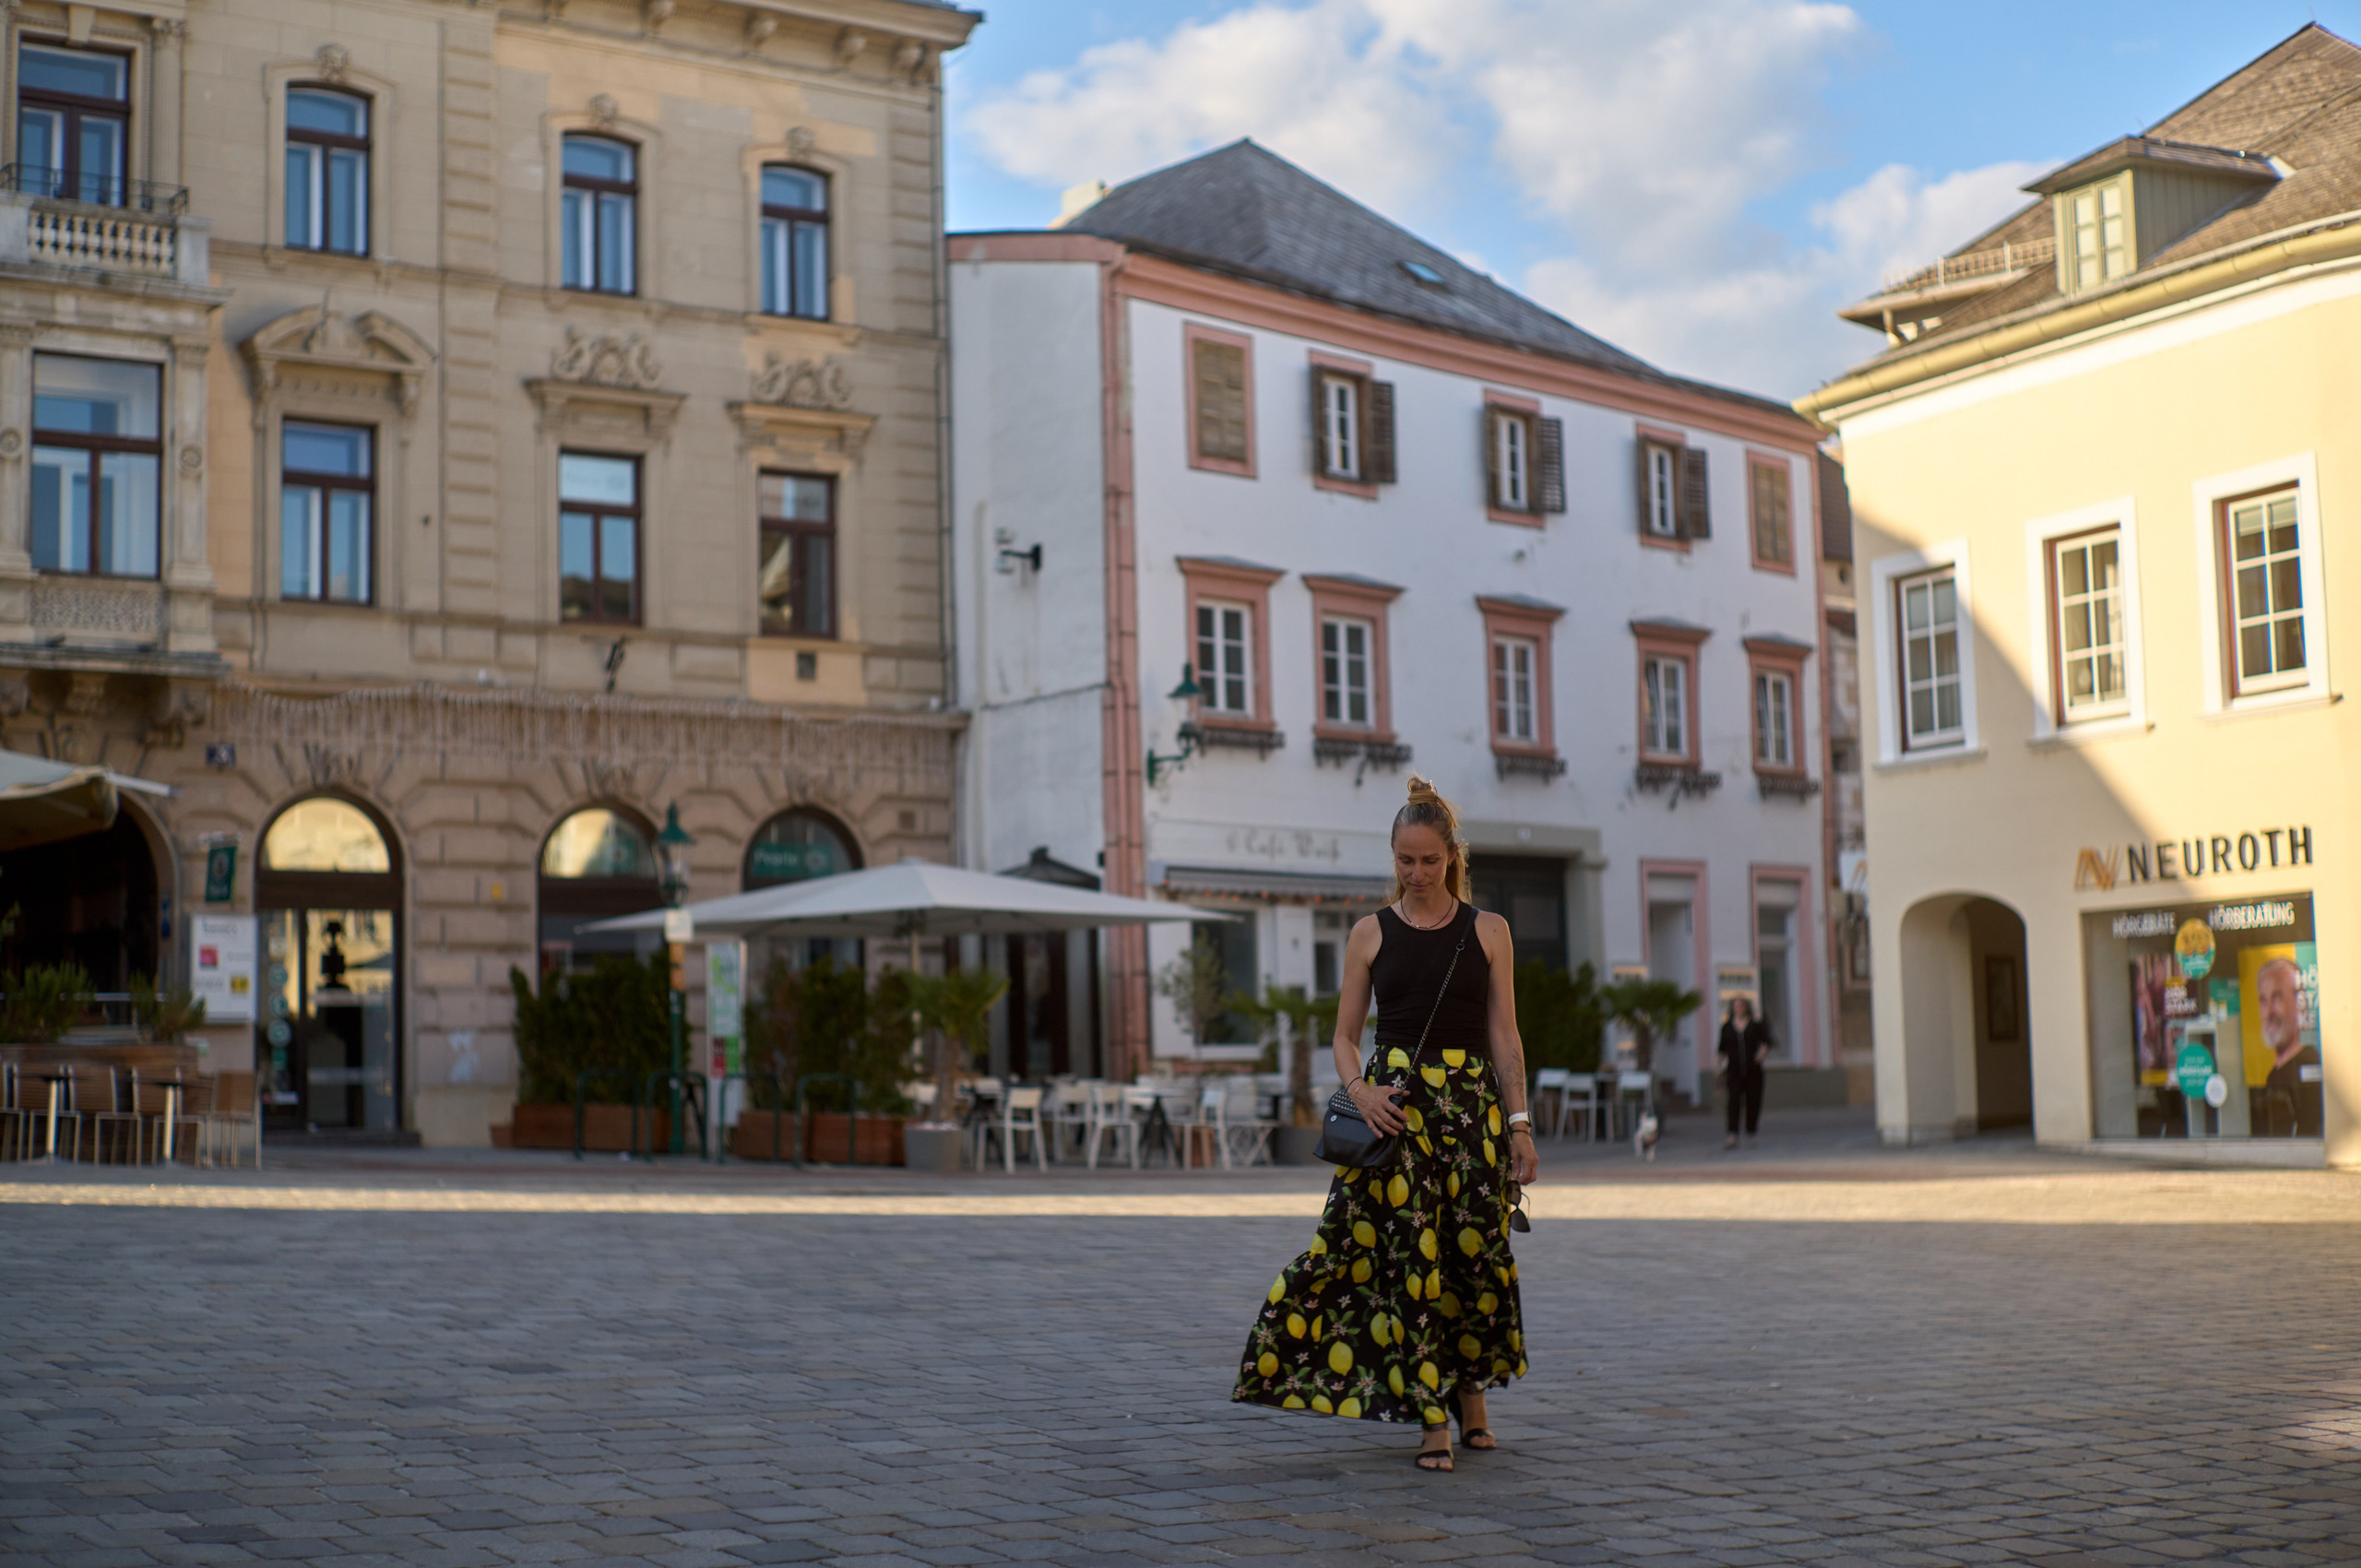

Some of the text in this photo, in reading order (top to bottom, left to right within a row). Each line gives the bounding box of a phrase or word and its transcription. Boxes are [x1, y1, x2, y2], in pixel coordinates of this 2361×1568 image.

[2127, 824, 2313, 884] NEUROTH
[2112, 901, 2295, 939] HÖRGERÄTE HÖRBERATUNG
